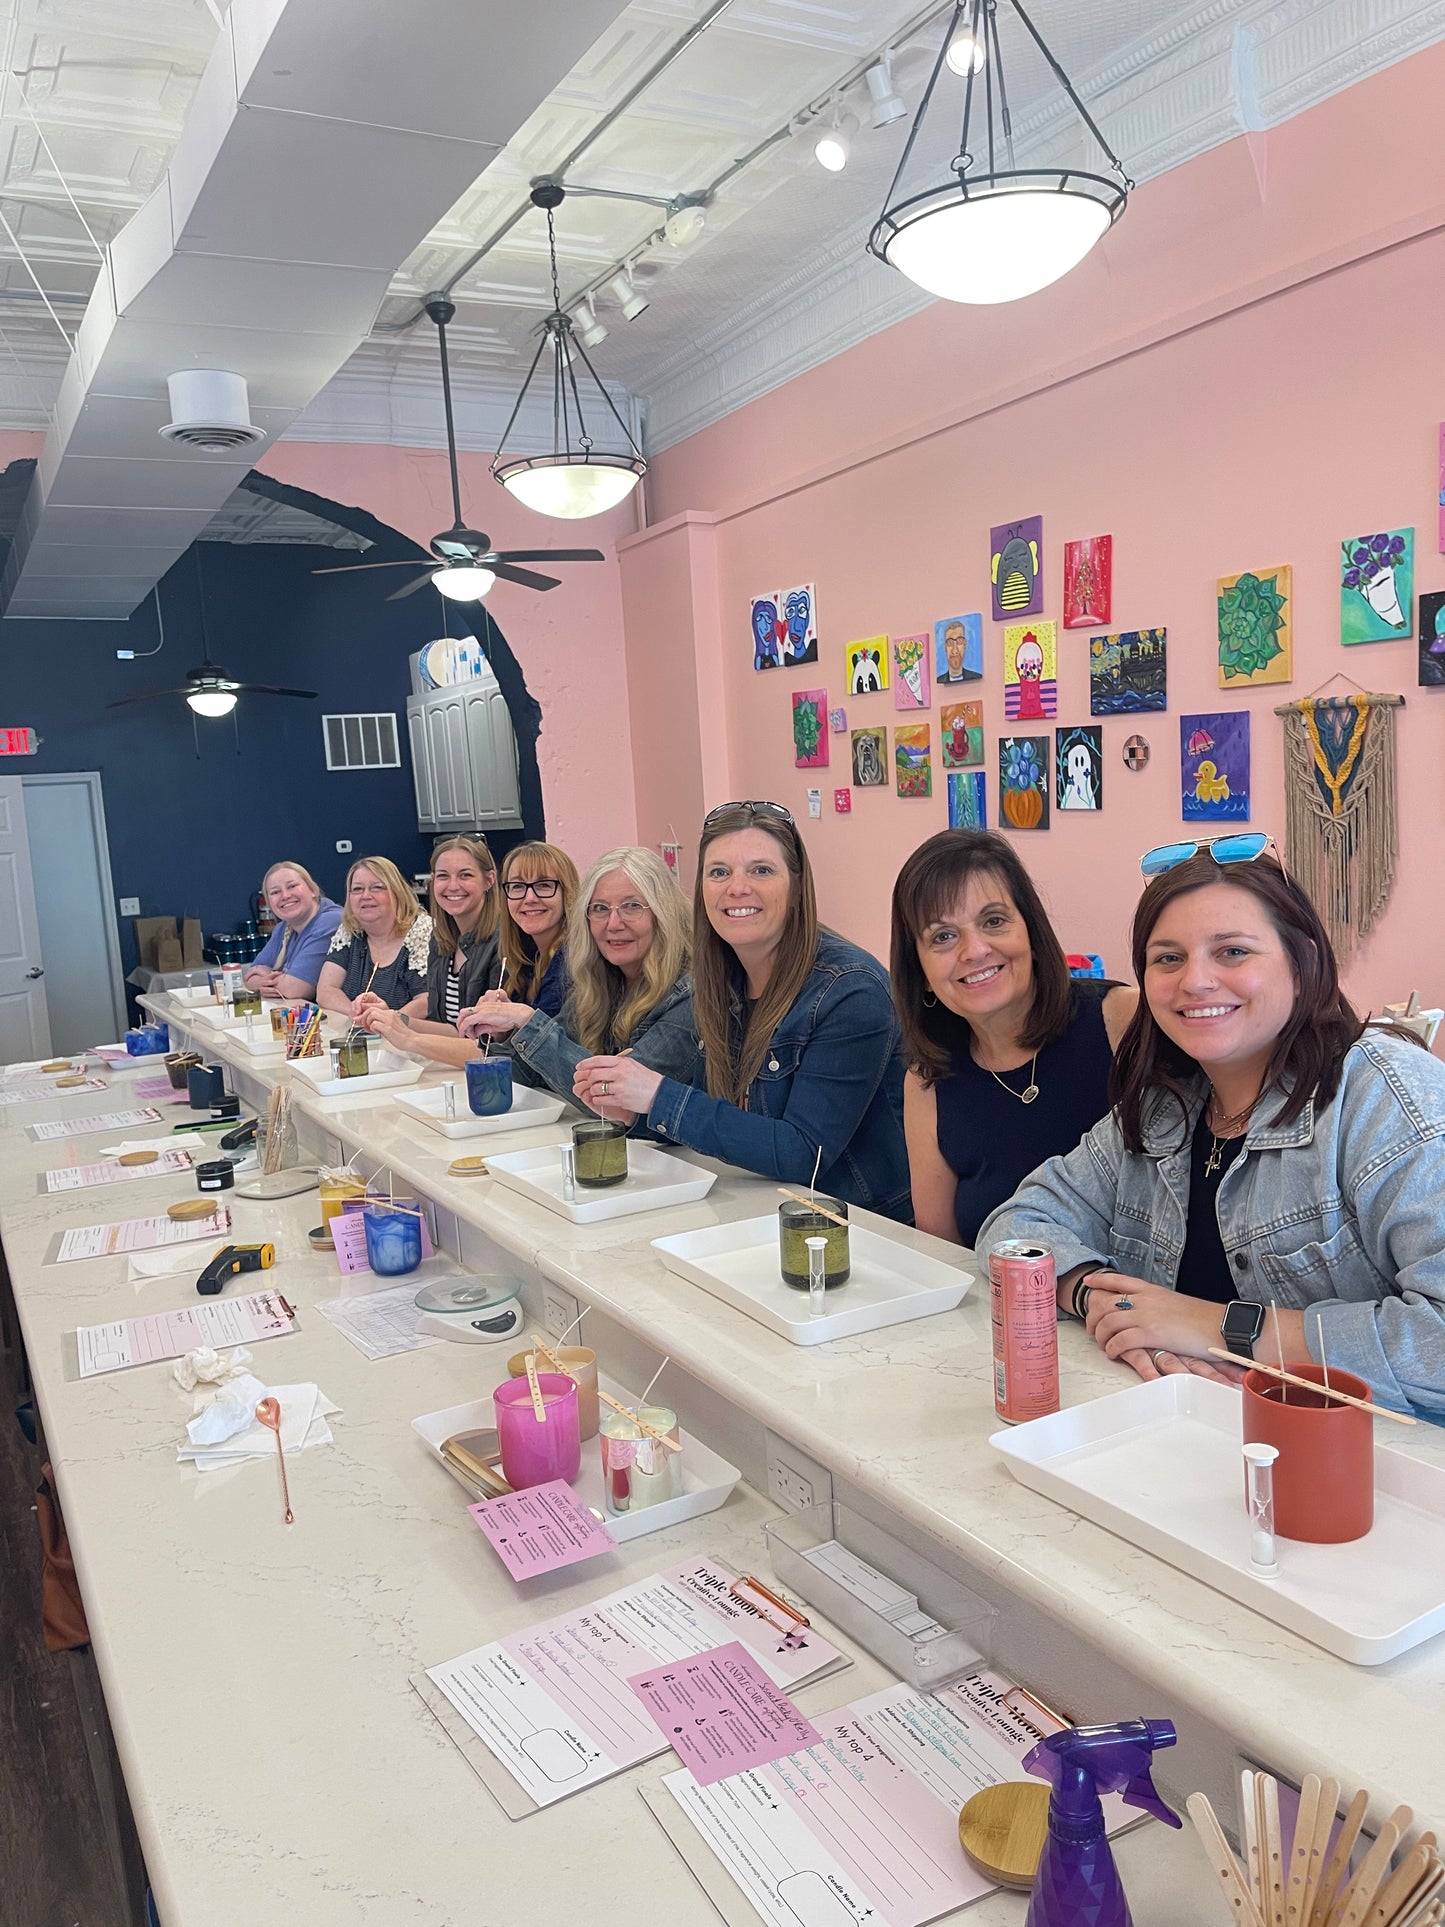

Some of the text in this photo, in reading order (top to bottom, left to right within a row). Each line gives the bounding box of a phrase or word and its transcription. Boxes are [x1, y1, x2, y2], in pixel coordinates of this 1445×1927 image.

[0, 728, 29, 754] EXIT
[548, 1492, 568, 1511] CANDLE
[562, 1509, 578, 1523] CARE
[694, 1567, 727, 1593] Triple
[686, 1578, 715, 1599] Creative
[712, 1596, 740, 1618] Lounge
[578, 1617, 592, 1628] My
[589, 1626, 603, 1638] top
[612, 1629, 629, 1644] Fragrance
[502, 1660, 513, 1670] Grand
[510, 1668, 520, 1679] Finale
[724, 1661, 748, 1688] CANDLE
[745, 1686, 766, 1706] CARE
[966, 1674, 1002, 1707] Triple
[929, 1693, 947, 1708] ustomer
[945, 1707, 970, 1729] Information
[957, 1684, 992, 1714] Creative
[990, 1712, 1026, 1743] Lounge
[564, 1729, 587, 1753] Candle Name
[834, 1725, 850, 1739] My
[847, 1738, 864, 1754] top
[884, 1707, 902, 1723] Address
[906, 1728, 926, 1747] Shipping
[851, 1721, 896, 1766] Choose Your Fragrance
[748, 1772, 772, 1800] Grand Finale
[827, 1875, 856, 1908] Candle Name
